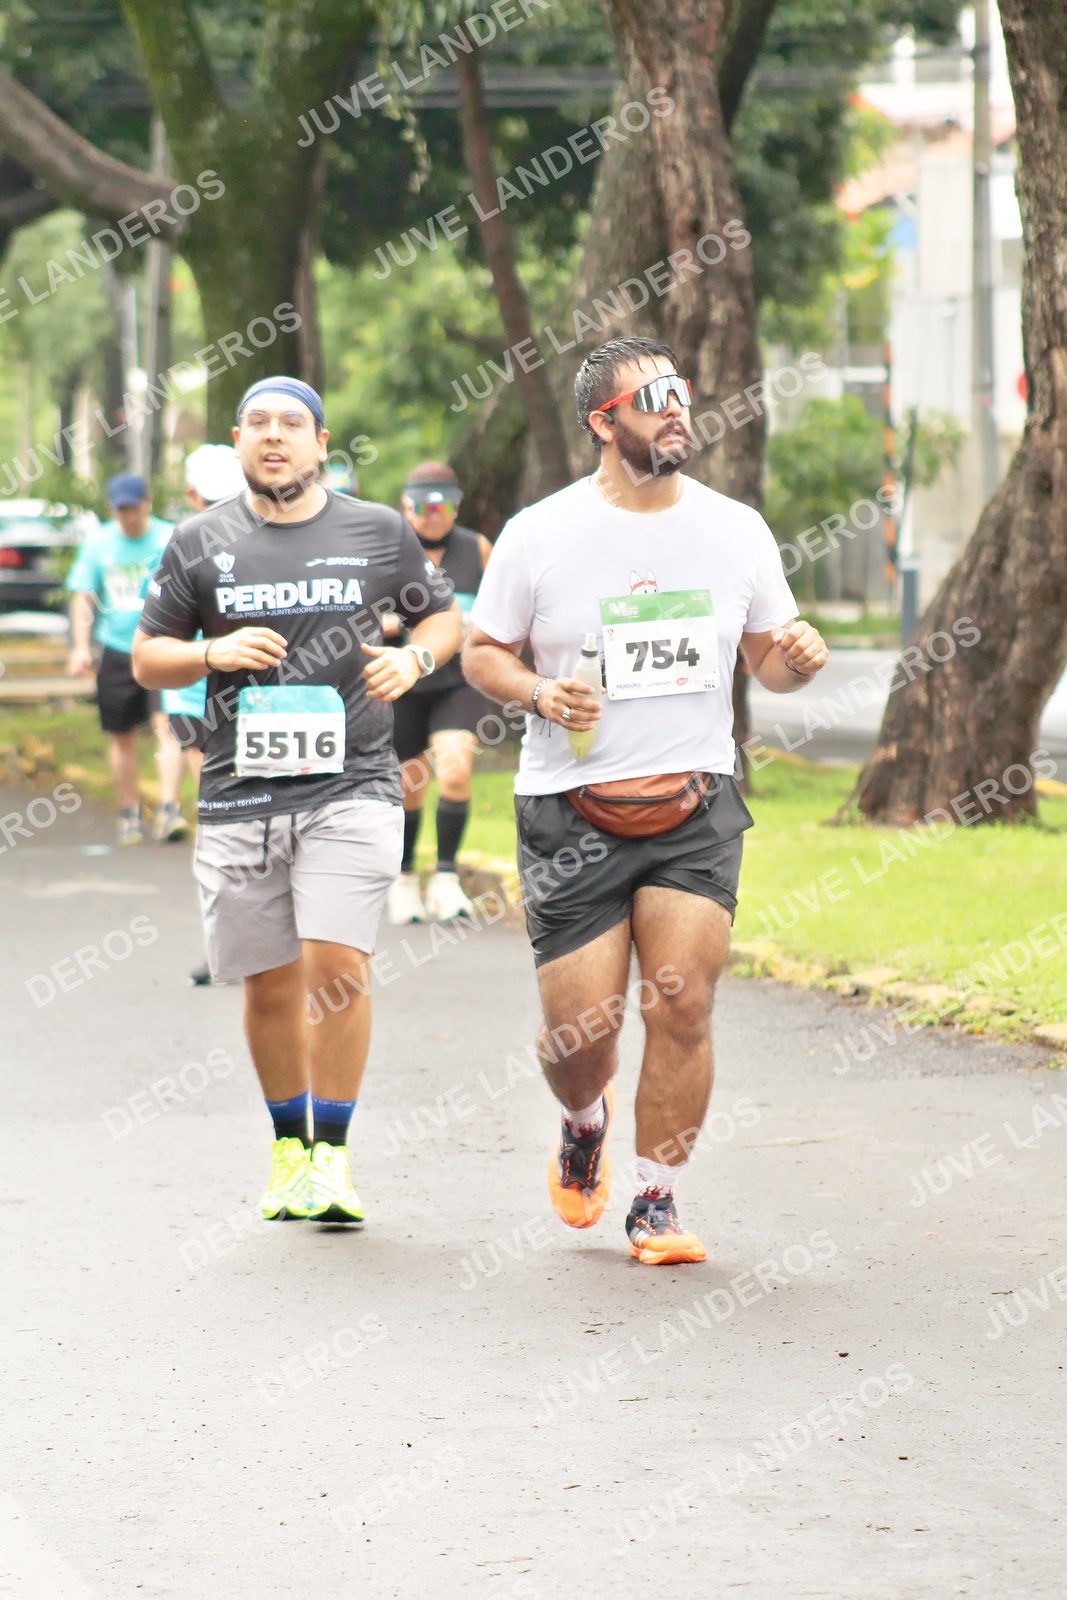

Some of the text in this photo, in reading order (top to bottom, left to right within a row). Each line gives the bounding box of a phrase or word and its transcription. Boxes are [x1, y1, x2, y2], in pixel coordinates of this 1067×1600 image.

[325, 557, 369, 567] BROOKS
[216, 578, 363, 614] PERDURA
[270, 605, 320, 617] JUNTEADORES
[324, 604, 356, 612] ESTUCOS
[625, 637, 700, 672] 754
[245, 731, 336, 760] 5516
[237, 794, 272, 807] corriendo
